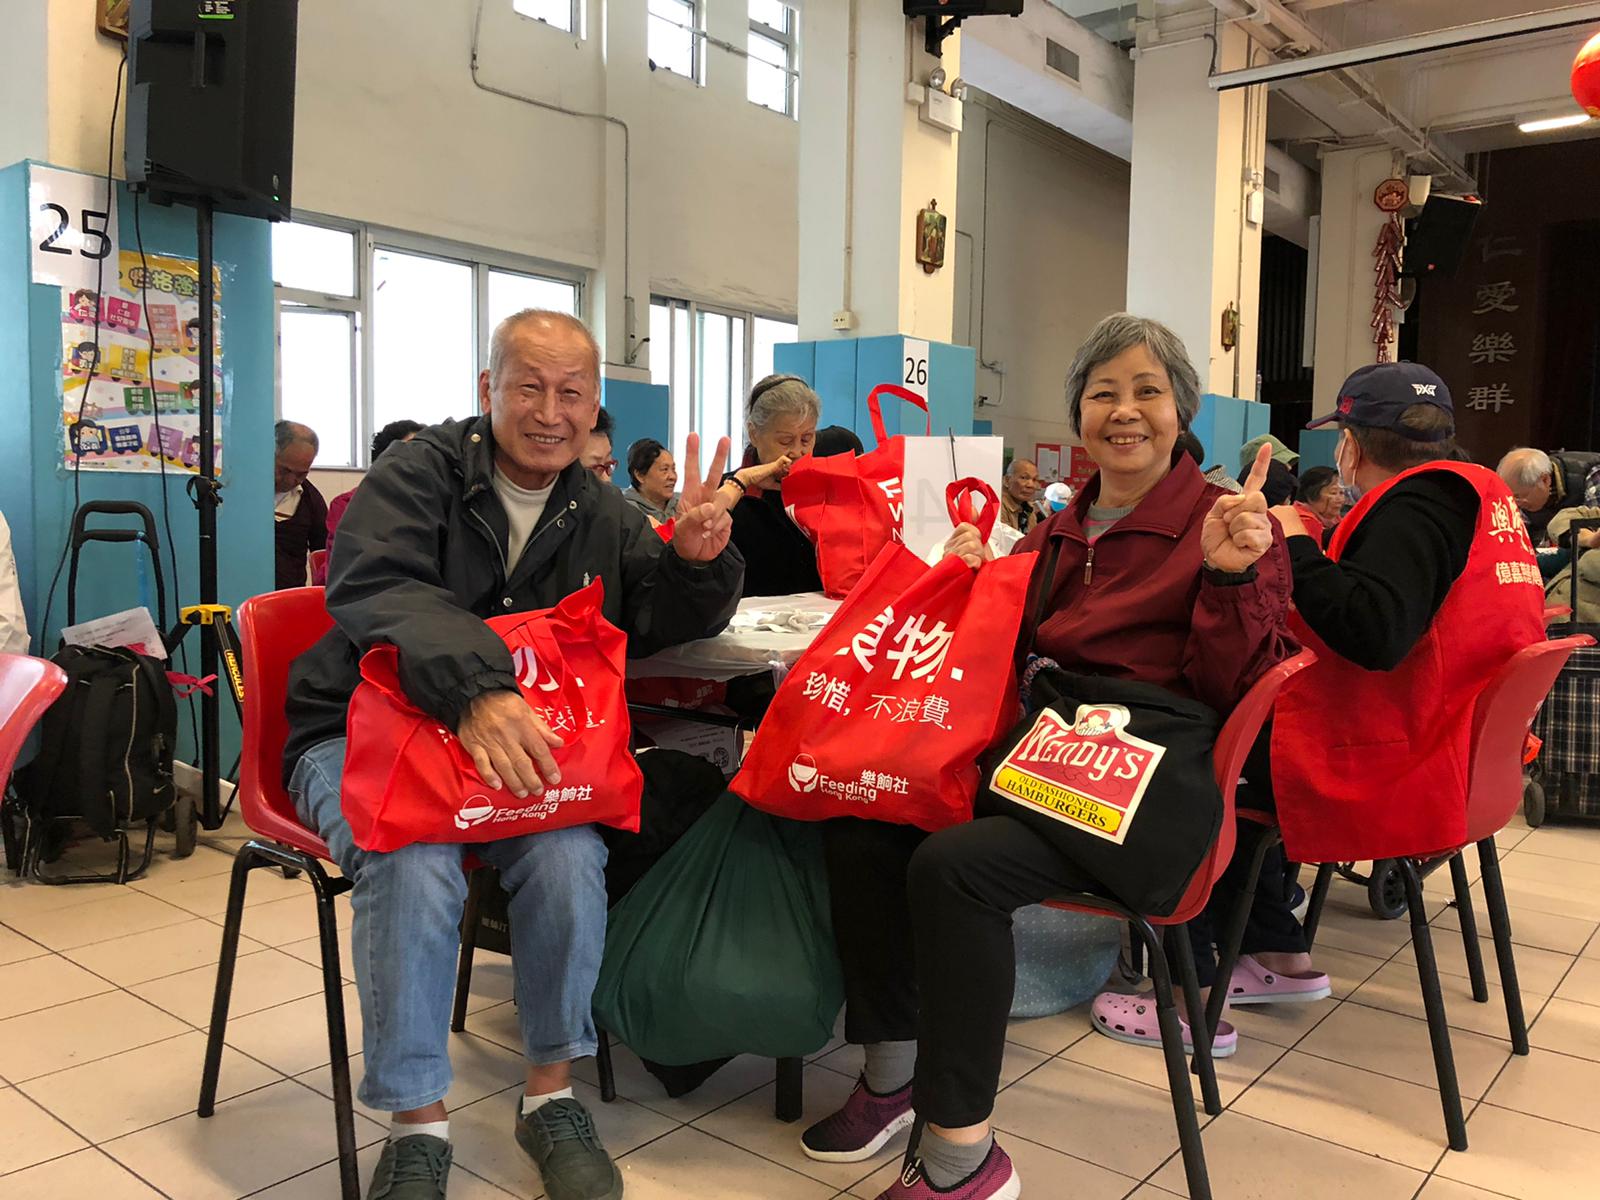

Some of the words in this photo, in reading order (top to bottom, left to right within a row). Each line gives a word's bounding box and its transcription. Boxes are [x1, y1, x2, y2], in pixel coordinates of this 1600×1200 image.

[39, 203, 112, 259] 25
[1465, 235, 1522, 413] 仁愛樂群
[905, 356, 927, 386] 26
[820, 775, 877, 801] Feeding
[1006, 779, 1107, 828] HAMBURGERS
[1019, 775, 1037, 788] OLD
[1037, 780, 1099, 812] FASHIONED
[495, 802, 559, 818] Feeding
[521, 811, 546, 820] Kong
